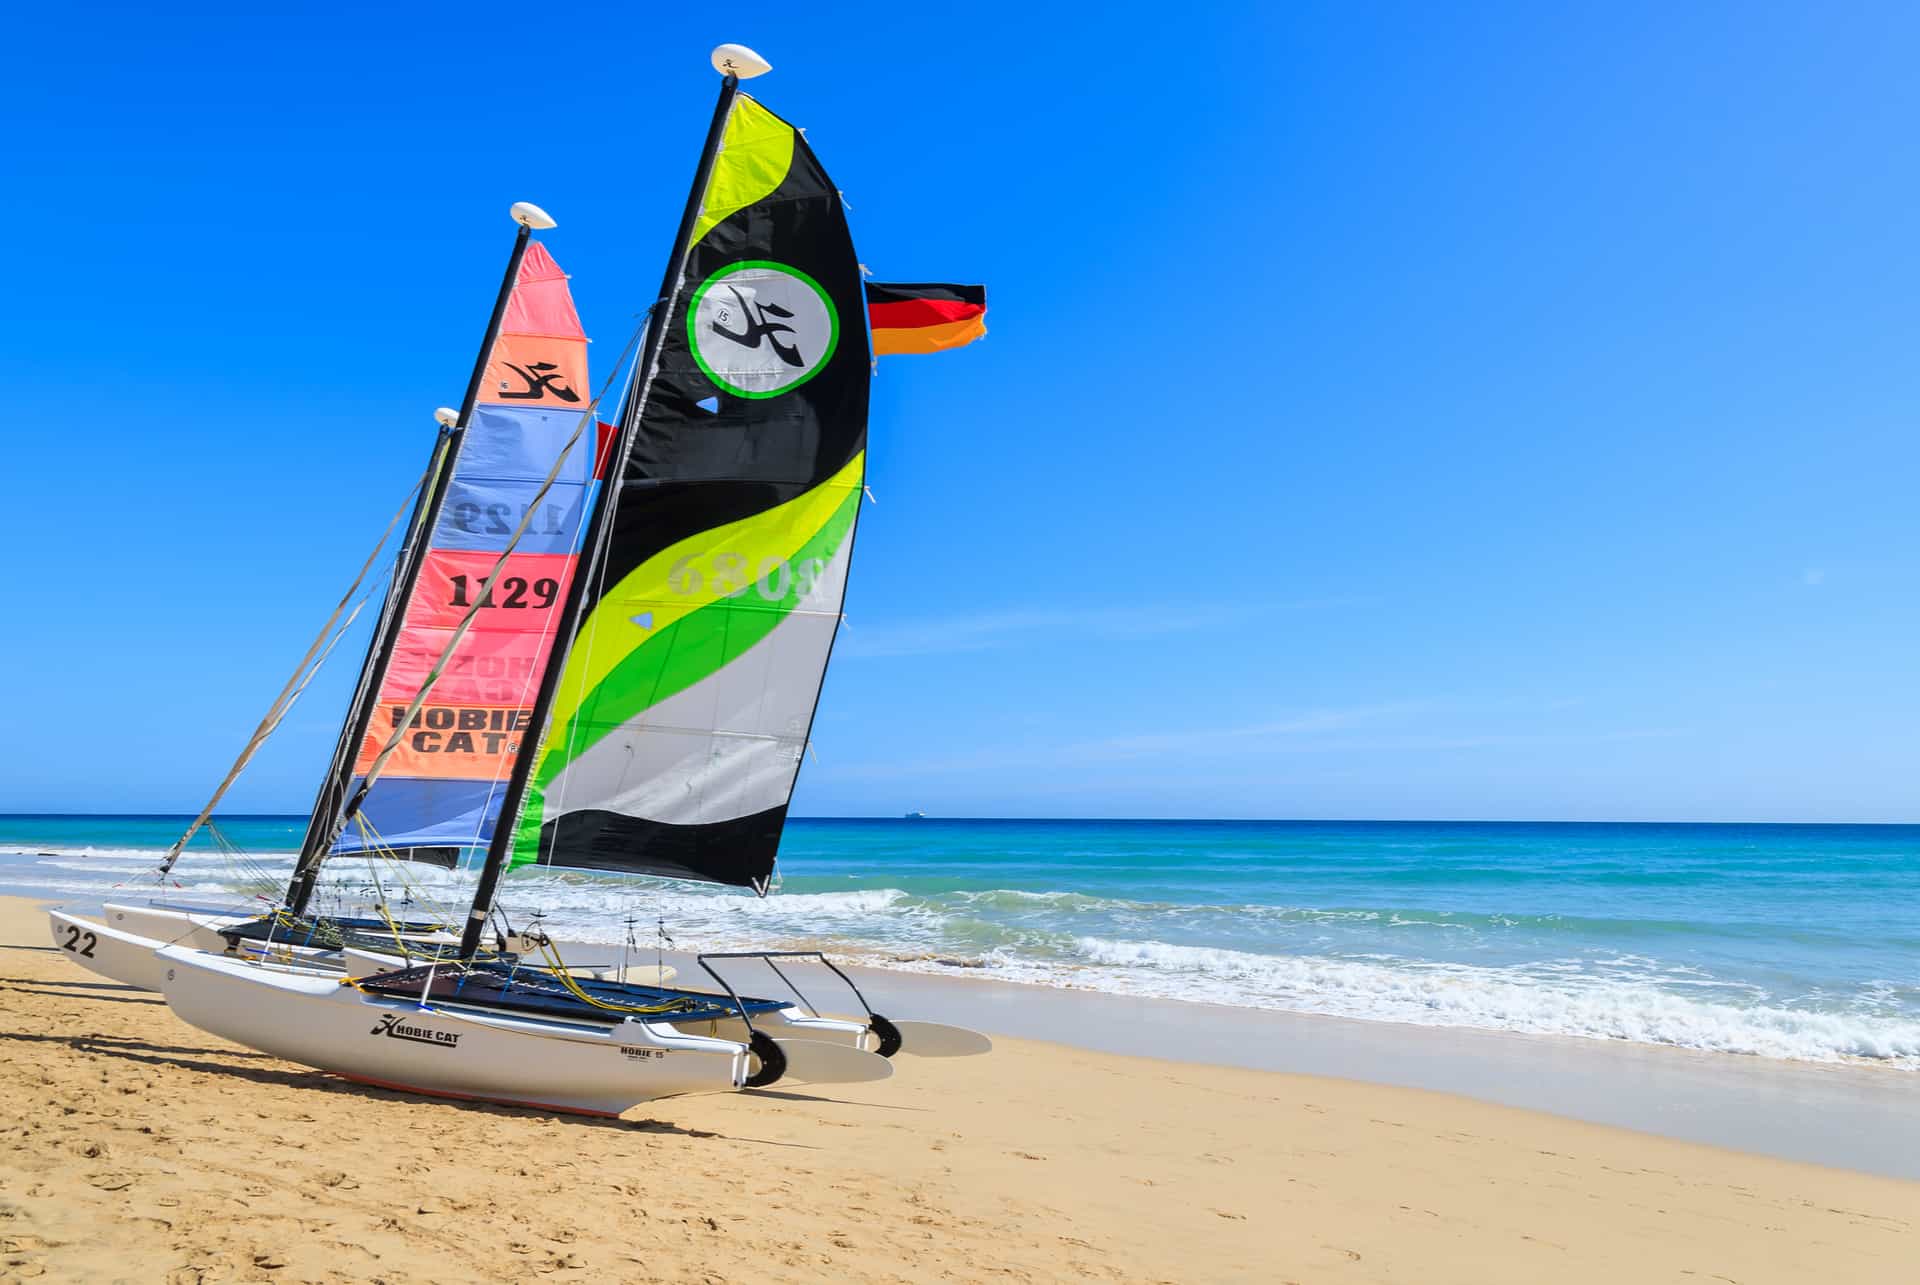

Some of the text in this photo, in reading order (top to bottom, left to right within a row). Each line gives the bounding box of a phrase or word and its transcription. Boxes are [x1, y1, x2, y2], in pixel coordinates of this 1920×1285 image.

[448, 575, 559, 608] 1129
[392, 706, 531, 731] HOBIE
[412, 731, 506, 754] CAT
[63, 925, 97, 959] 22
[397, 1025, 460, 1042] HOBIE CAT
[621, 1047, 651, 1057] HOBIE
